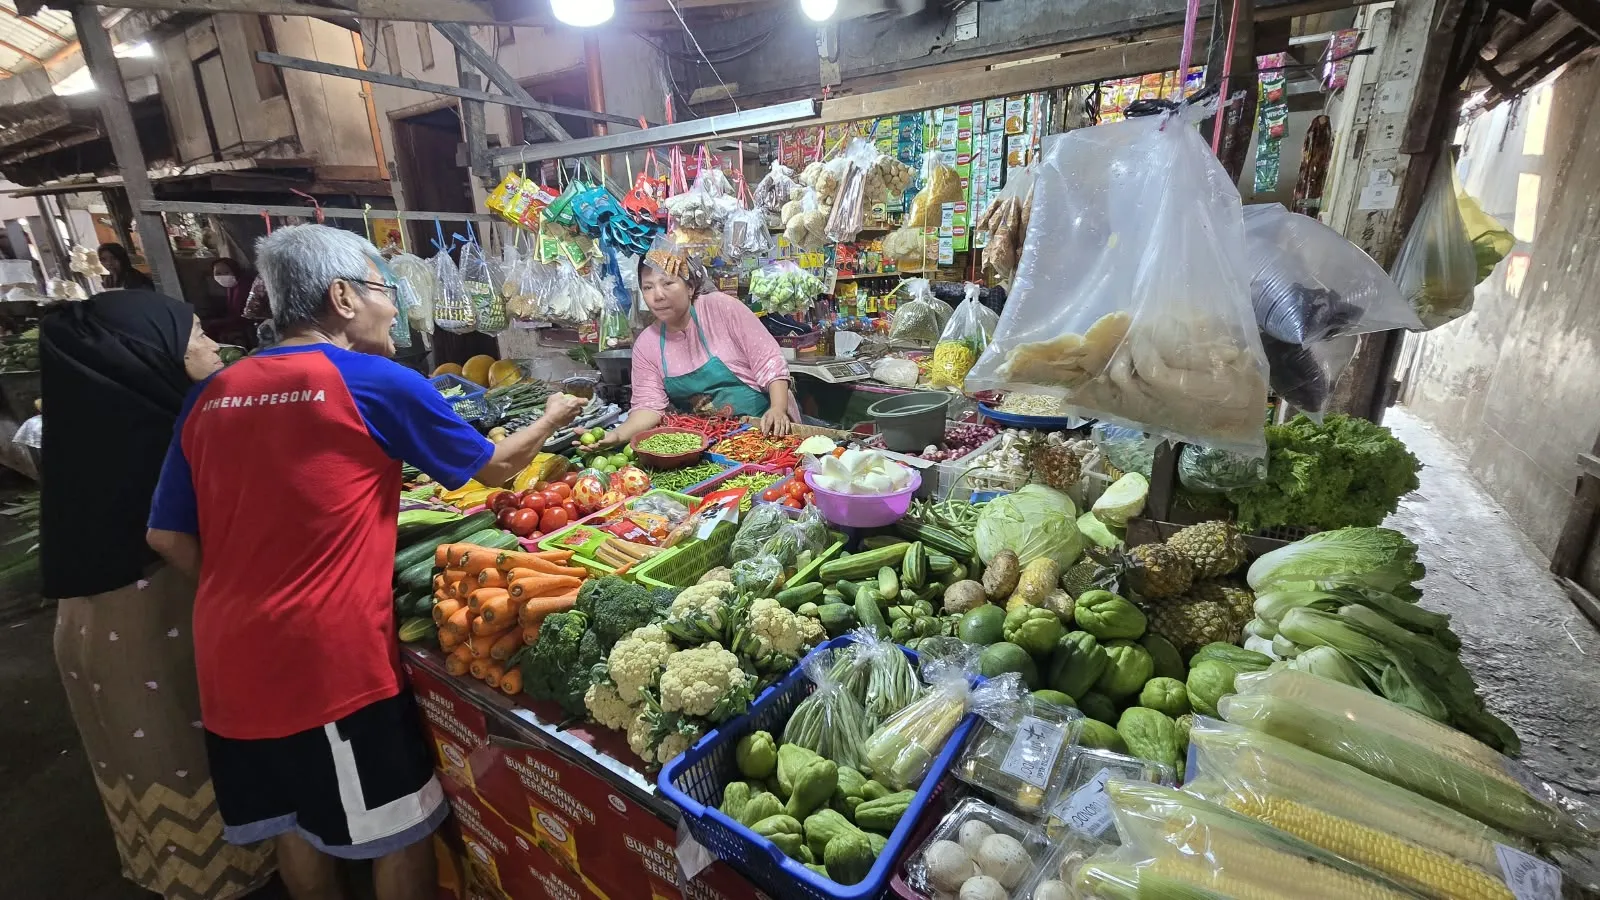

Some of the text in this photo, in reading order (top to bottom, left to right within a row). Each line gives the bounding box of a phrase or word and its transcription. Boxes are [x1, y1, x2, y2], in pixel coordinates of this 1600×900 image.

[526, 755, 559, 780] BARU!
[505, 755, 539, 781] BUMBU
[541, 778, 594, 822] MARINASI
[521, 774, 580, 822] SERBAGUNA
[624, 835, 670, 869] BUMBU
